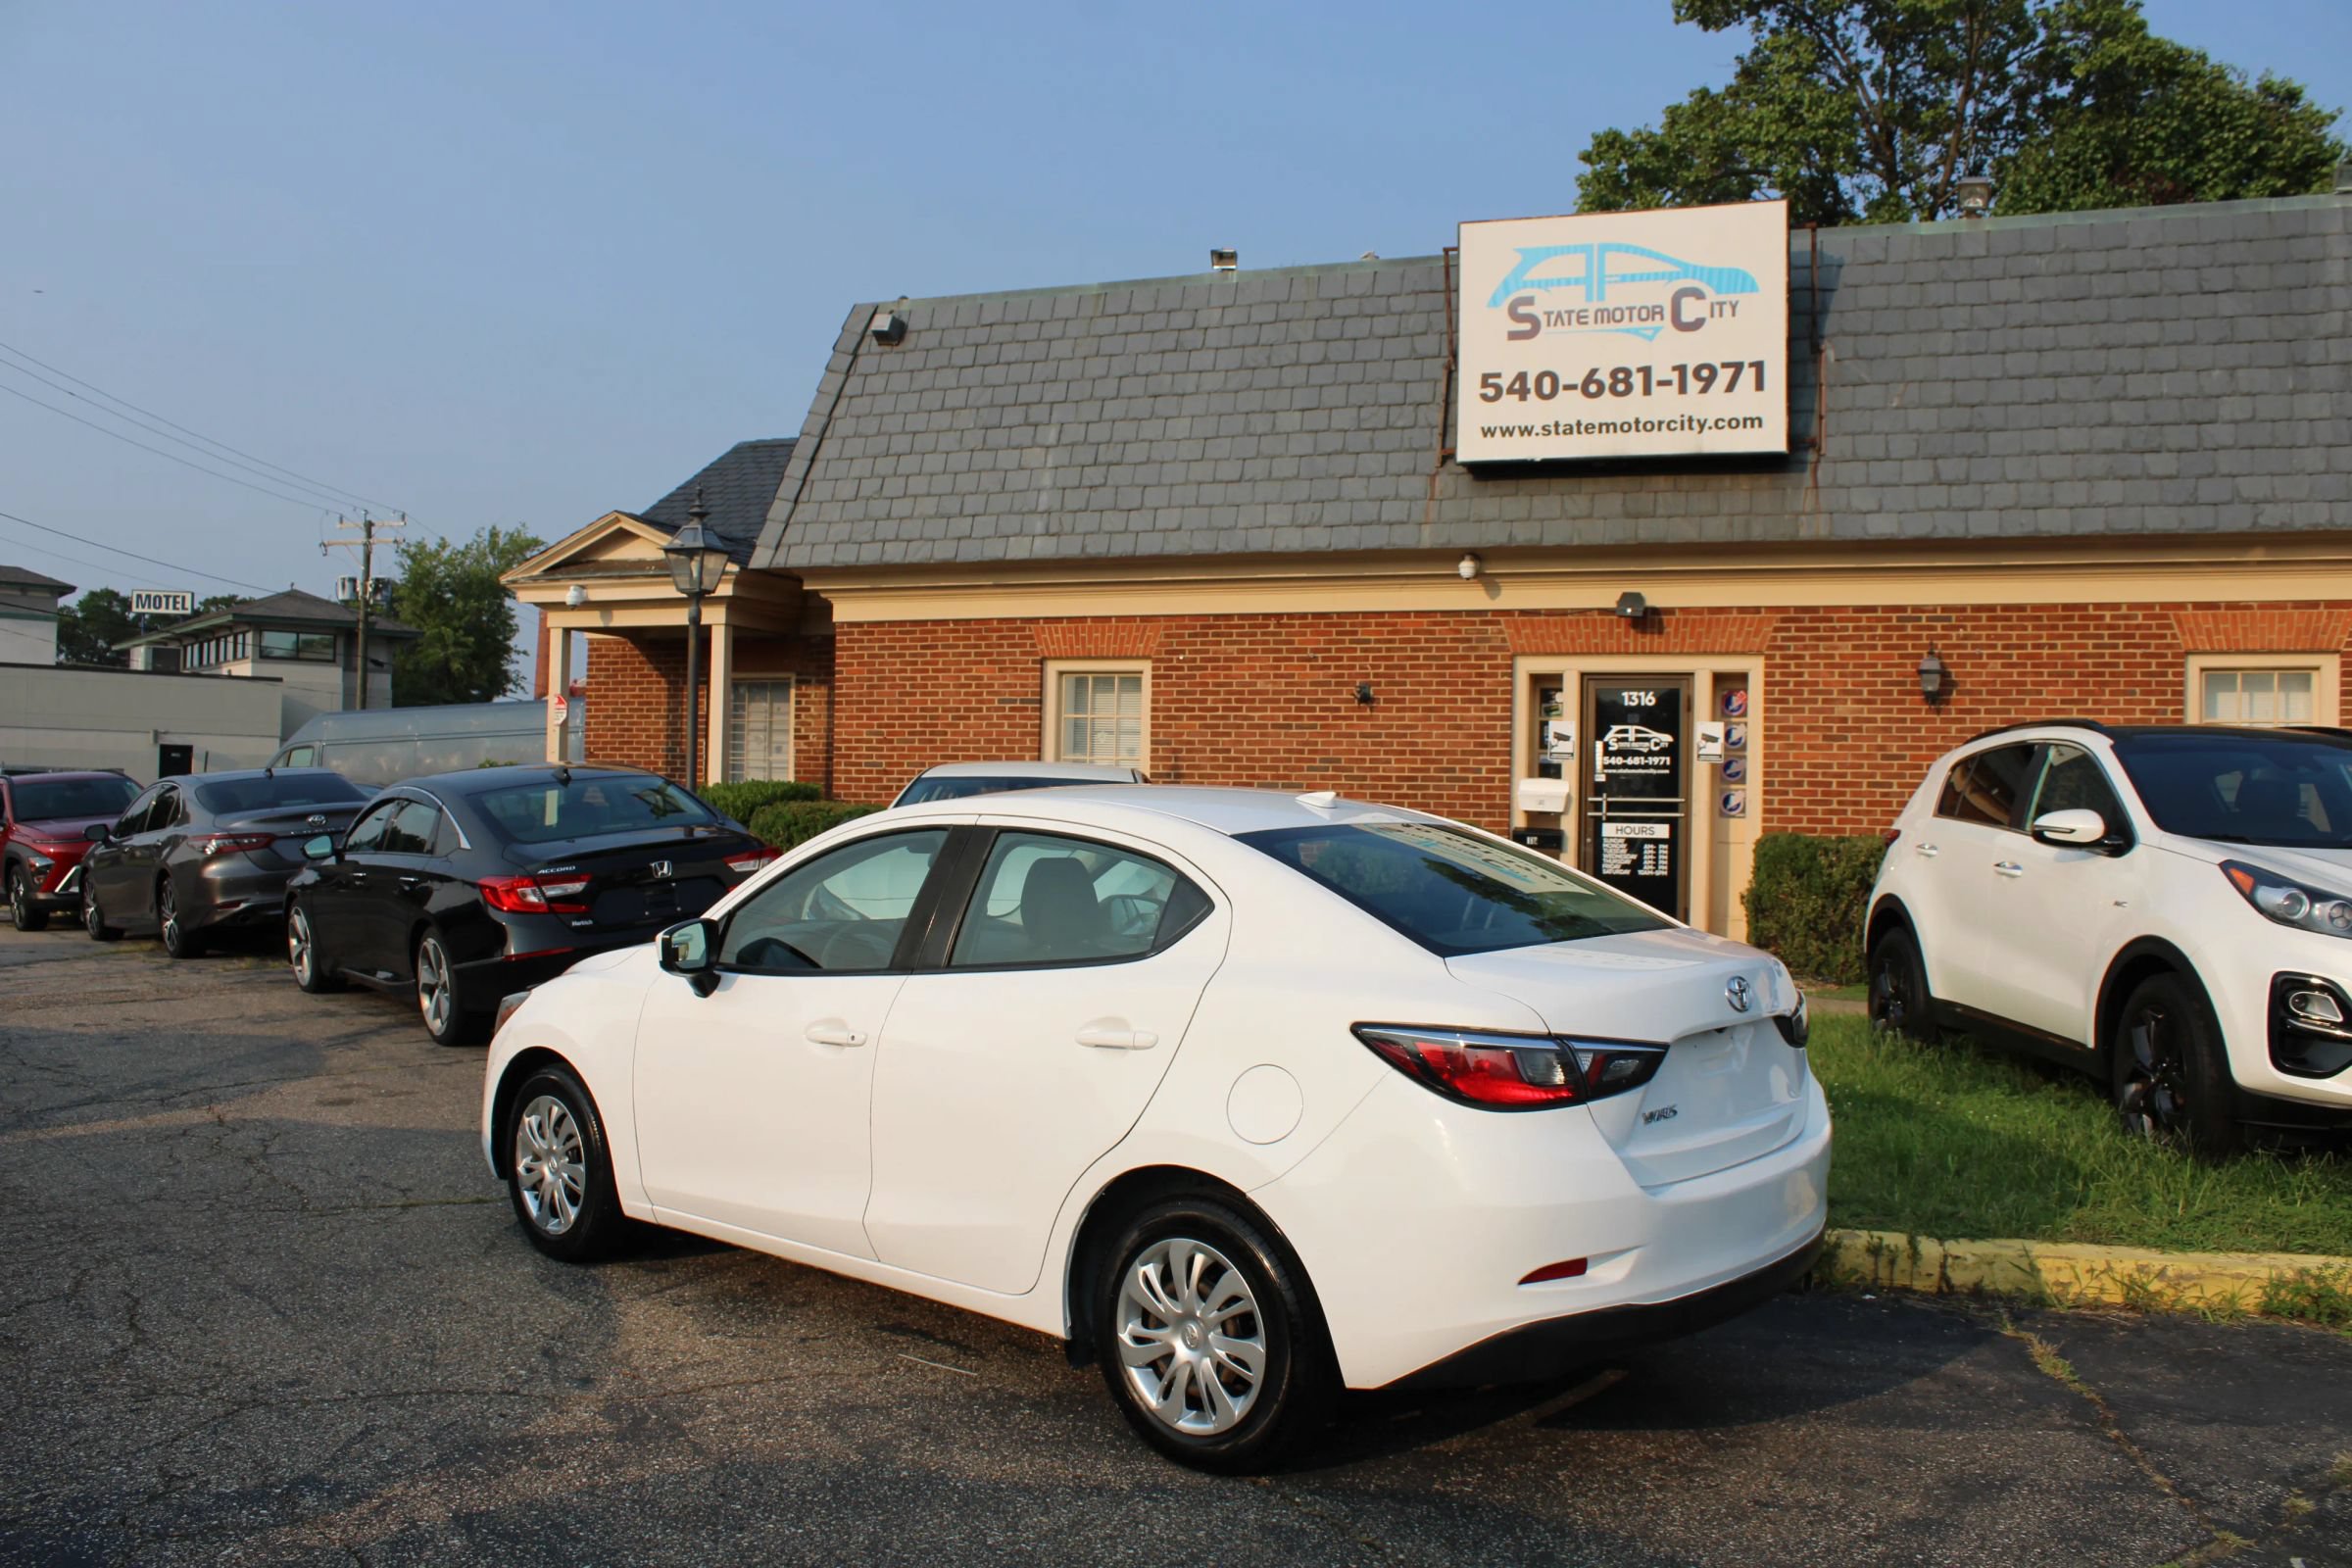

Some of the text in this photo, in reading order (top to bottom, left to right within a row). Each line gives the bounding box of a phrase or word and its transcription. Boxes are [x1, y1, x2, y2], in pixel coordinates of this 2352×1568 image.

[1506, 286, 1740, 342] STATE MOTOR CITY
[1479, 360, 1765, 403] 540-681-1971
[1481, 414, 1763, 438] www.statemotorcity.com
[135, 593, 189, 612] MOTEL
[1621, 691, 1656, 707] 1316
[1603, 756, 1671, 765] 540-681-1971
[1615, 825, 1655, 836] HOURS
[537, 865, 576, 874] ACCORD
